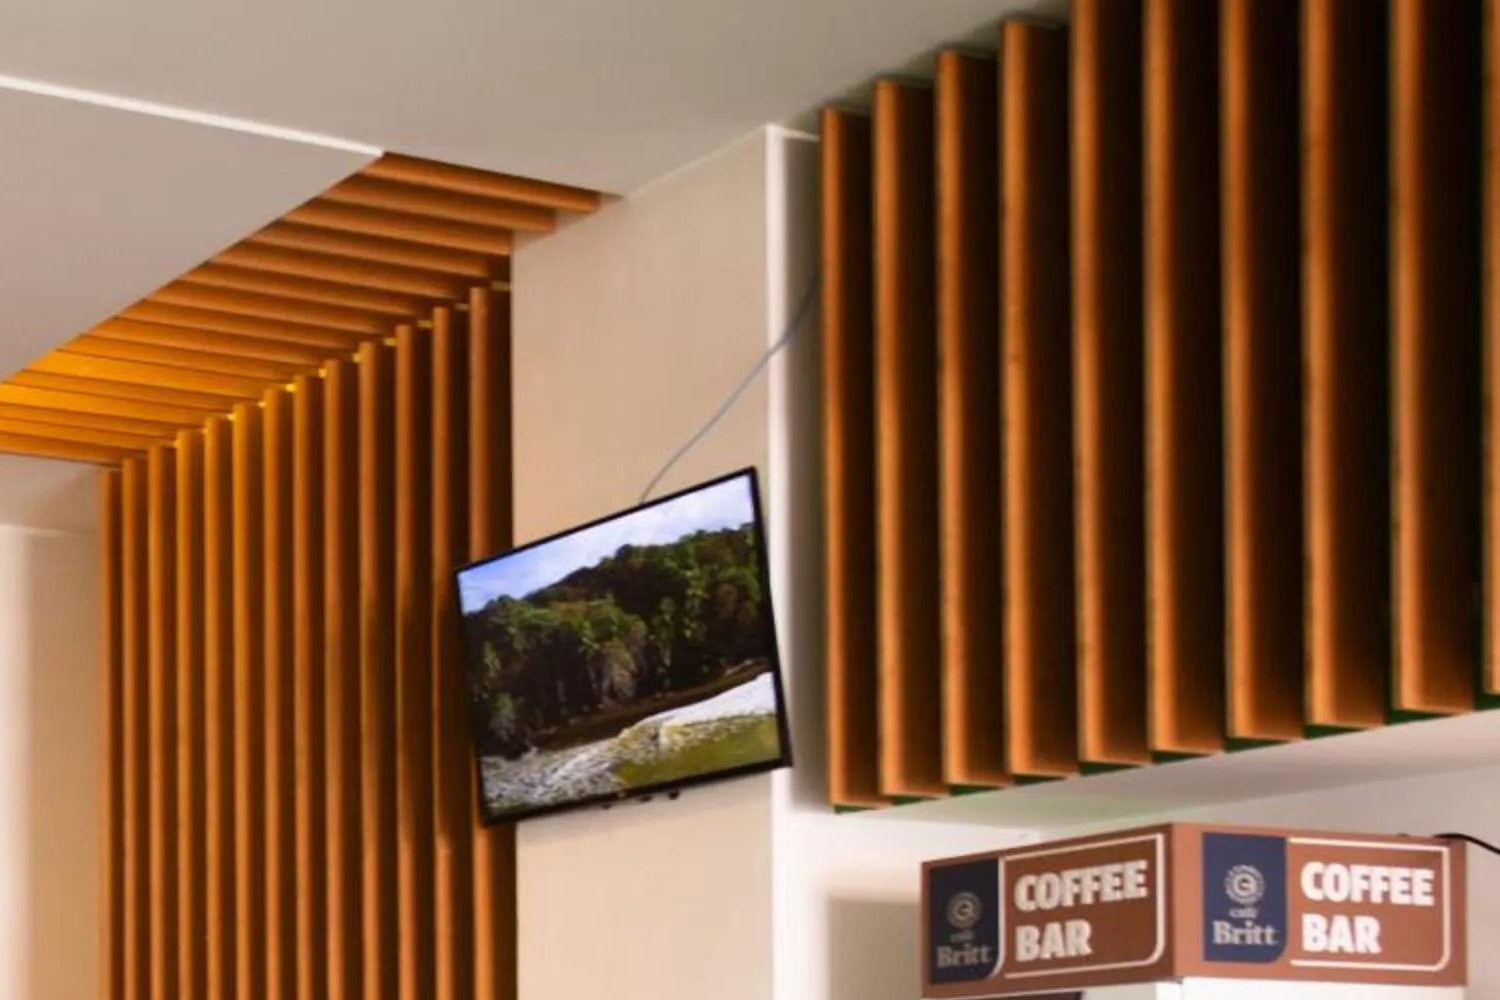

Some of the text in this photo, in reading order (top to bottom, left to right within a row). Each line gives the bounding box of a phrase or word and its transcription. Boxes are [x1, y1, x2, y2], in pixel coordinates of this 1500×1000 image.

[1014, 860, 1148, 912] COFFEE
[1301, 861, 1435, 907] COFFEE
[1015, 918, 1093, 962] BAR
[1212, 920, 1278, 946] Britt
[1302, 913, 1382, 954] BAR
[937, 944, 992, 968] Britt
